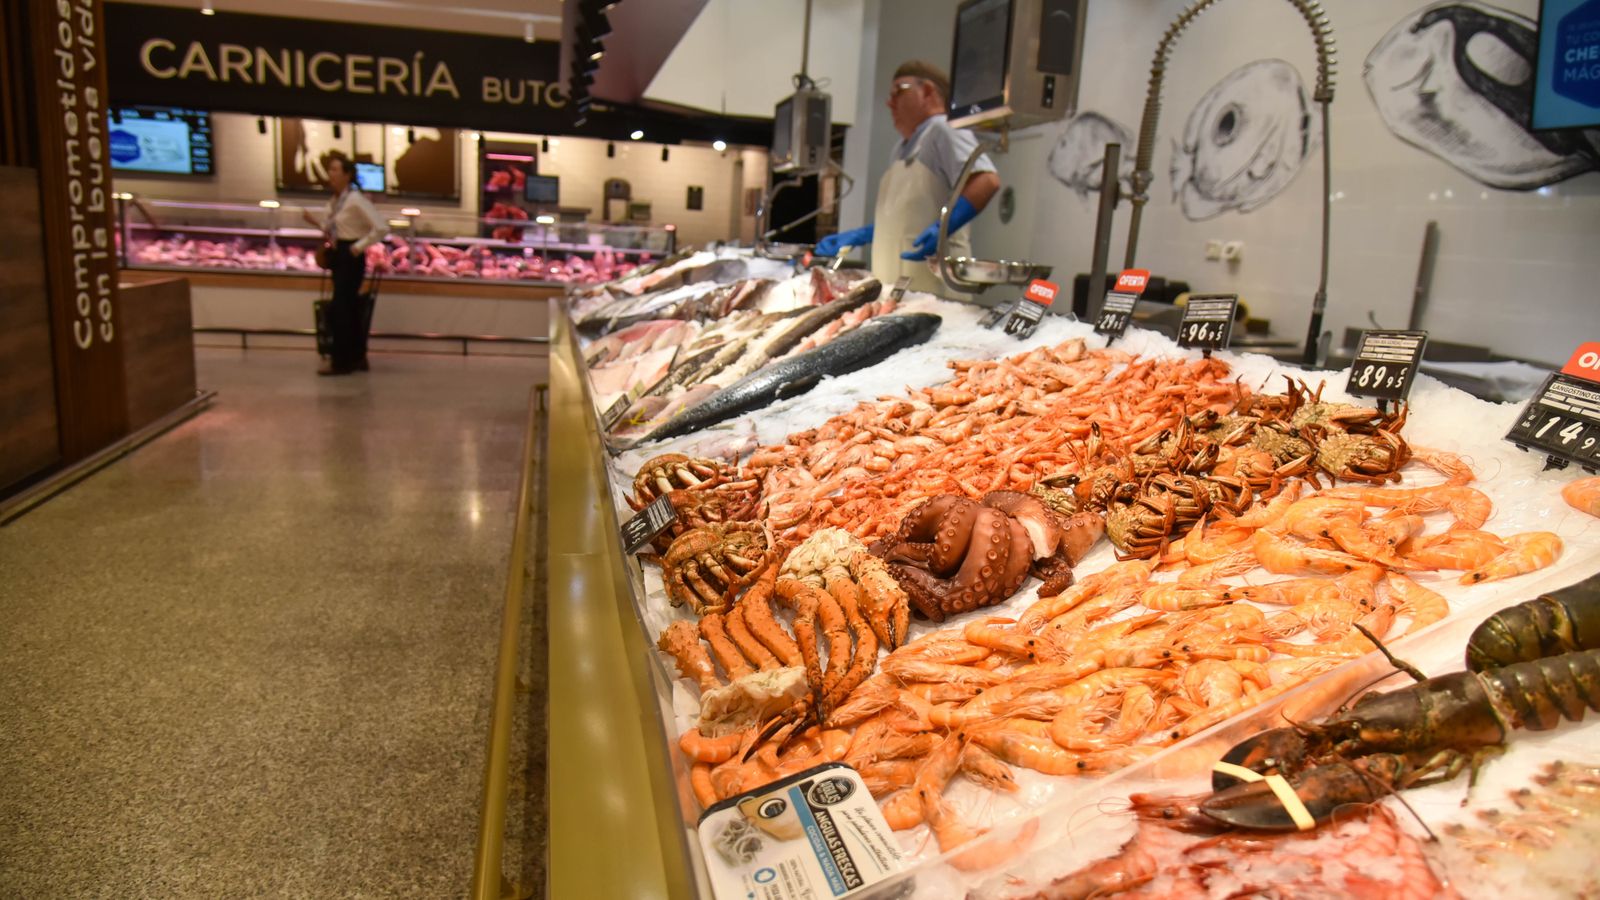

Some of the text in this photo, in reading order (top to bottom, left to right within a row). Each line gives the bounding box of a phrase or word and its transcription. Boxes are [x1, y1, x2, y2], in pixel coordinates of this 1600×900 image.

[140, 38, 571, 109] CARNICERÍA BUTC
[54, 0, 93, 349] Comprometidos
[84, 86, 105, 212] buena
[91, 227, 108, 259] la
[97, 273, 113, 342] con
[1358, 365, 1387, 388] 89
[1551, 383, 1591, 398] LANGOSTINO
[814, 811, 842, 851] ANGULAS
[832, 846, 861, 888] FRESCAS
